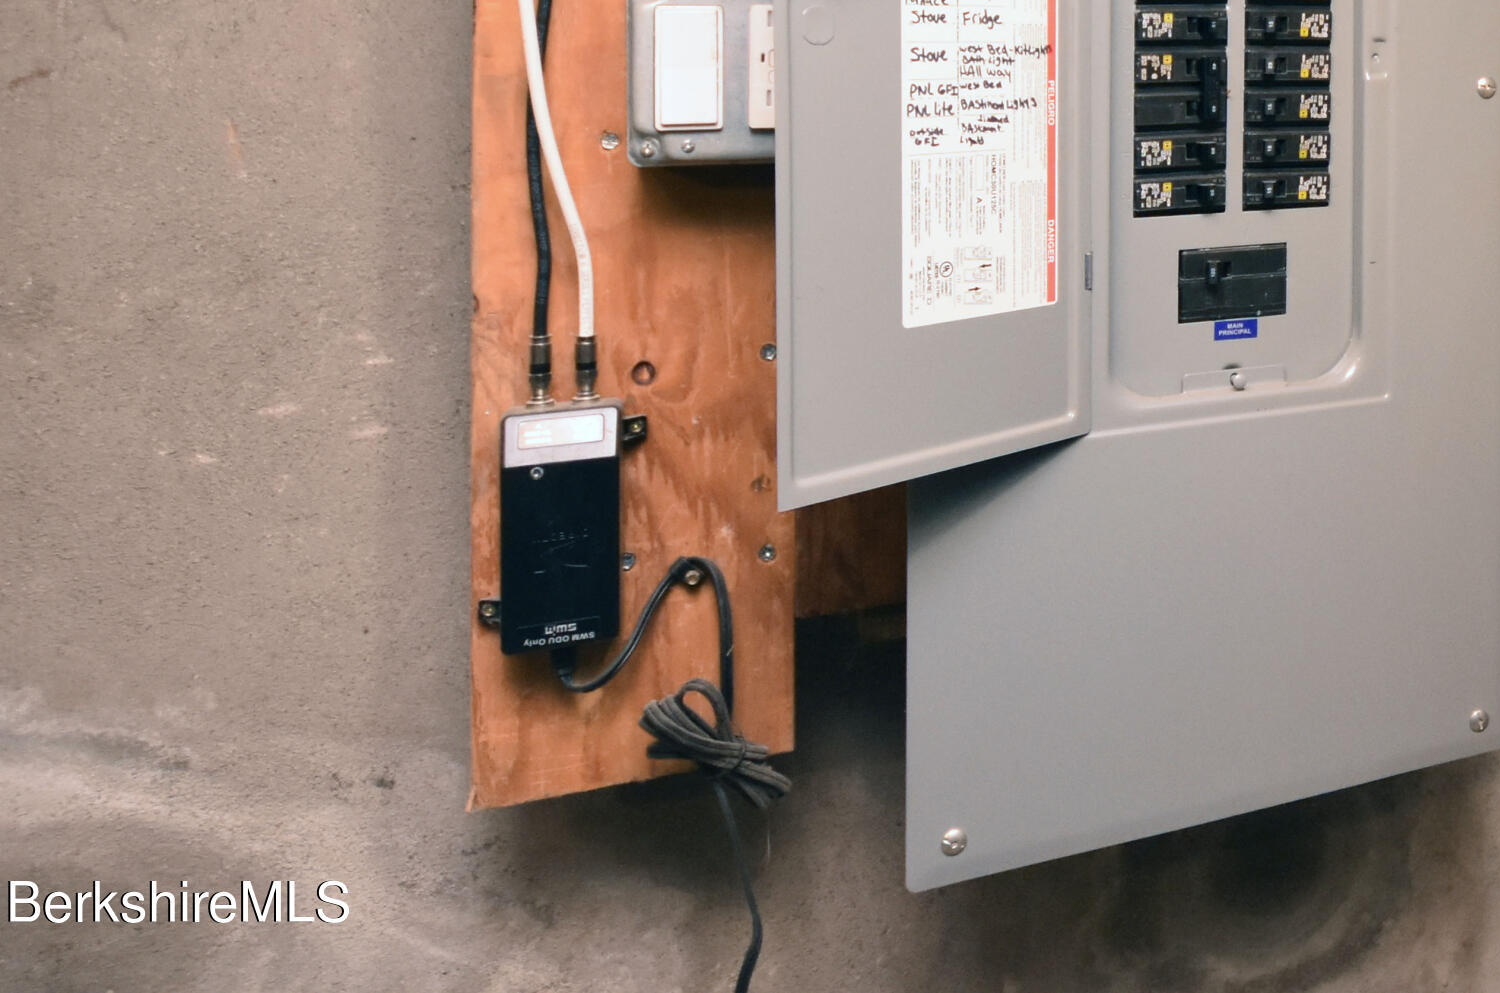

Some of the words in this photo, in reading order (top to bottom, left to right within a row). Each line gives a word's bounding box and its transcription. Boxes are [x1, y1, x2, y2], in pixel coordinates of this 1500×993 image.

[911, 9, 948, 25] Stove
[962, 9, 1003, 30] Fridge
[910, 46, 949, 63] Stove
[1047, 79, 1056, 127] PELIGRO
[1047, 218, 1055, 263] DANGER
[1218, 328, 1252, 336] PRINCIPAL
[523, 637, 546, 648] Only
[547, 634, 570, 645] ODU
[571, 631, 596, 642] SWM
